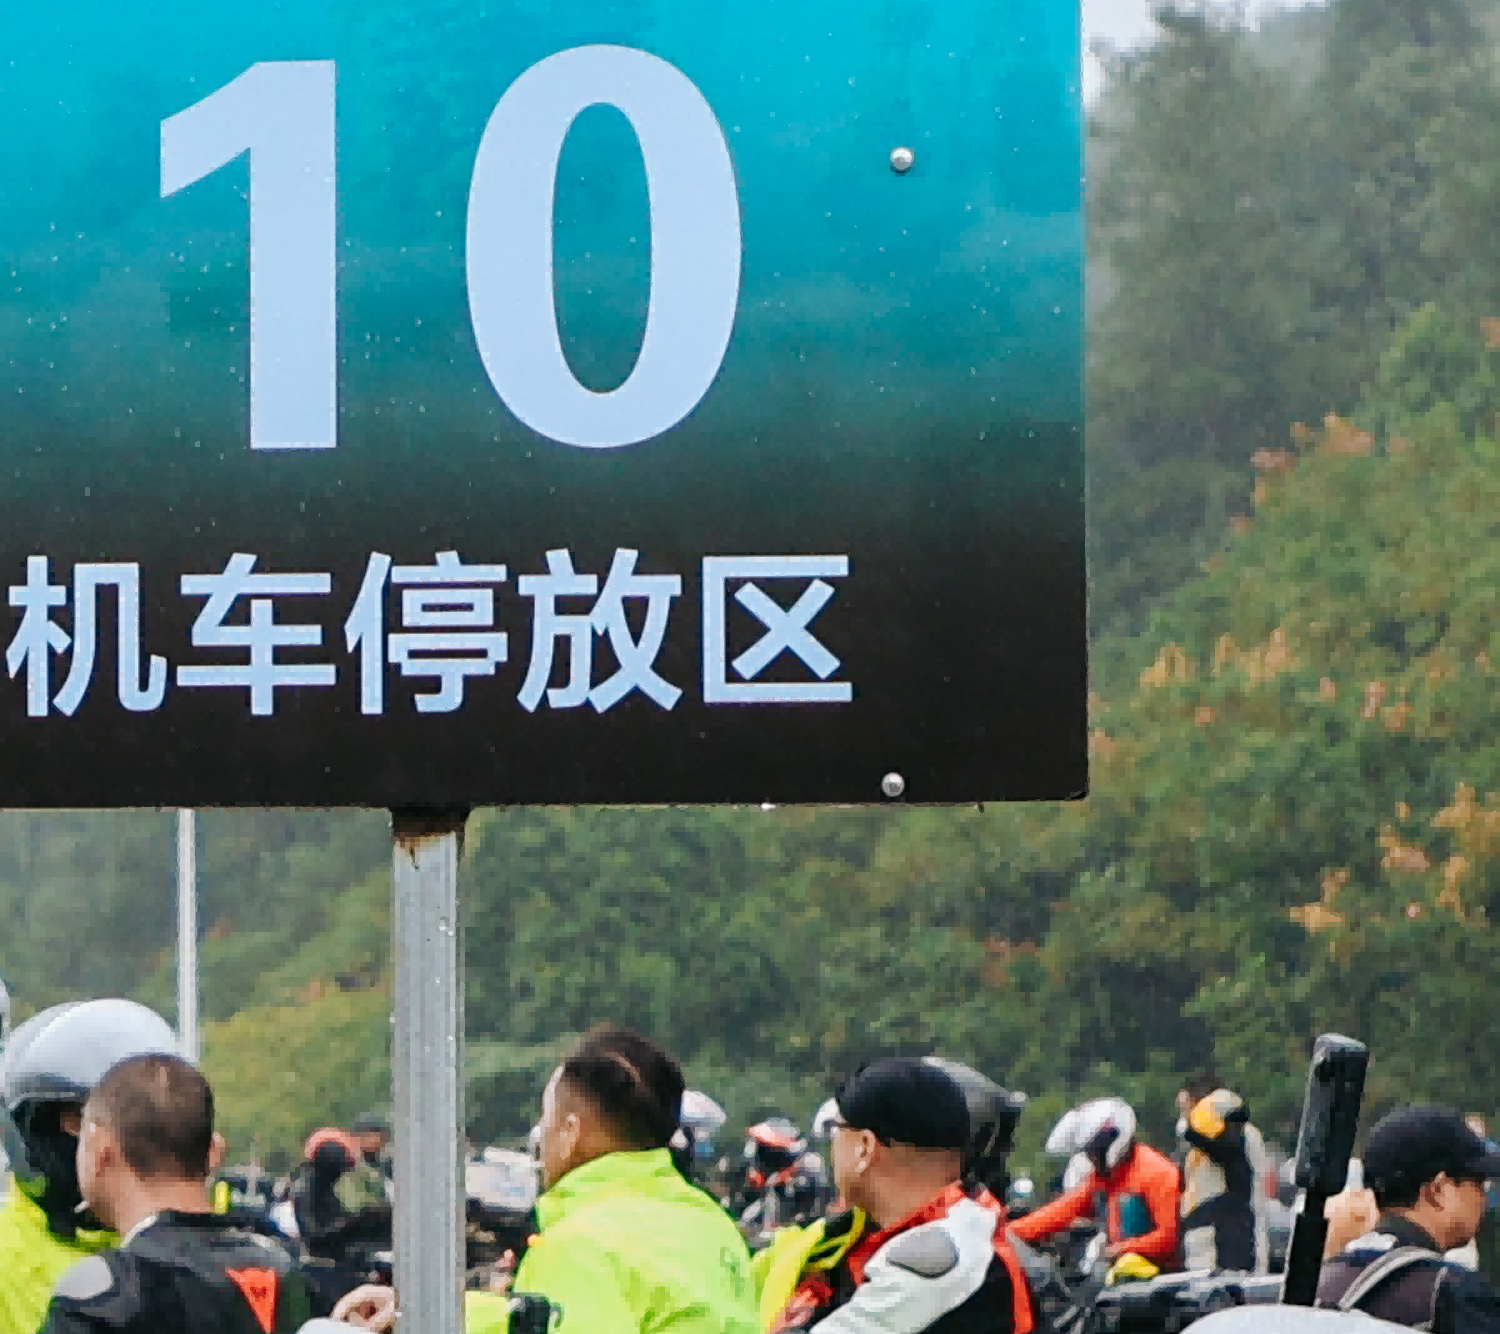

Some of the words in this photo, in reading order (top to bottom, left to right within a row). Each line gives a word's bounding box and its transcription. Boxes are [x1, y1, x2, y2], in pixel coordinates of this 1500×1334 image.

[159, 42, 743, 451] 10
[4, 547, 853, 718] 机车停放区
